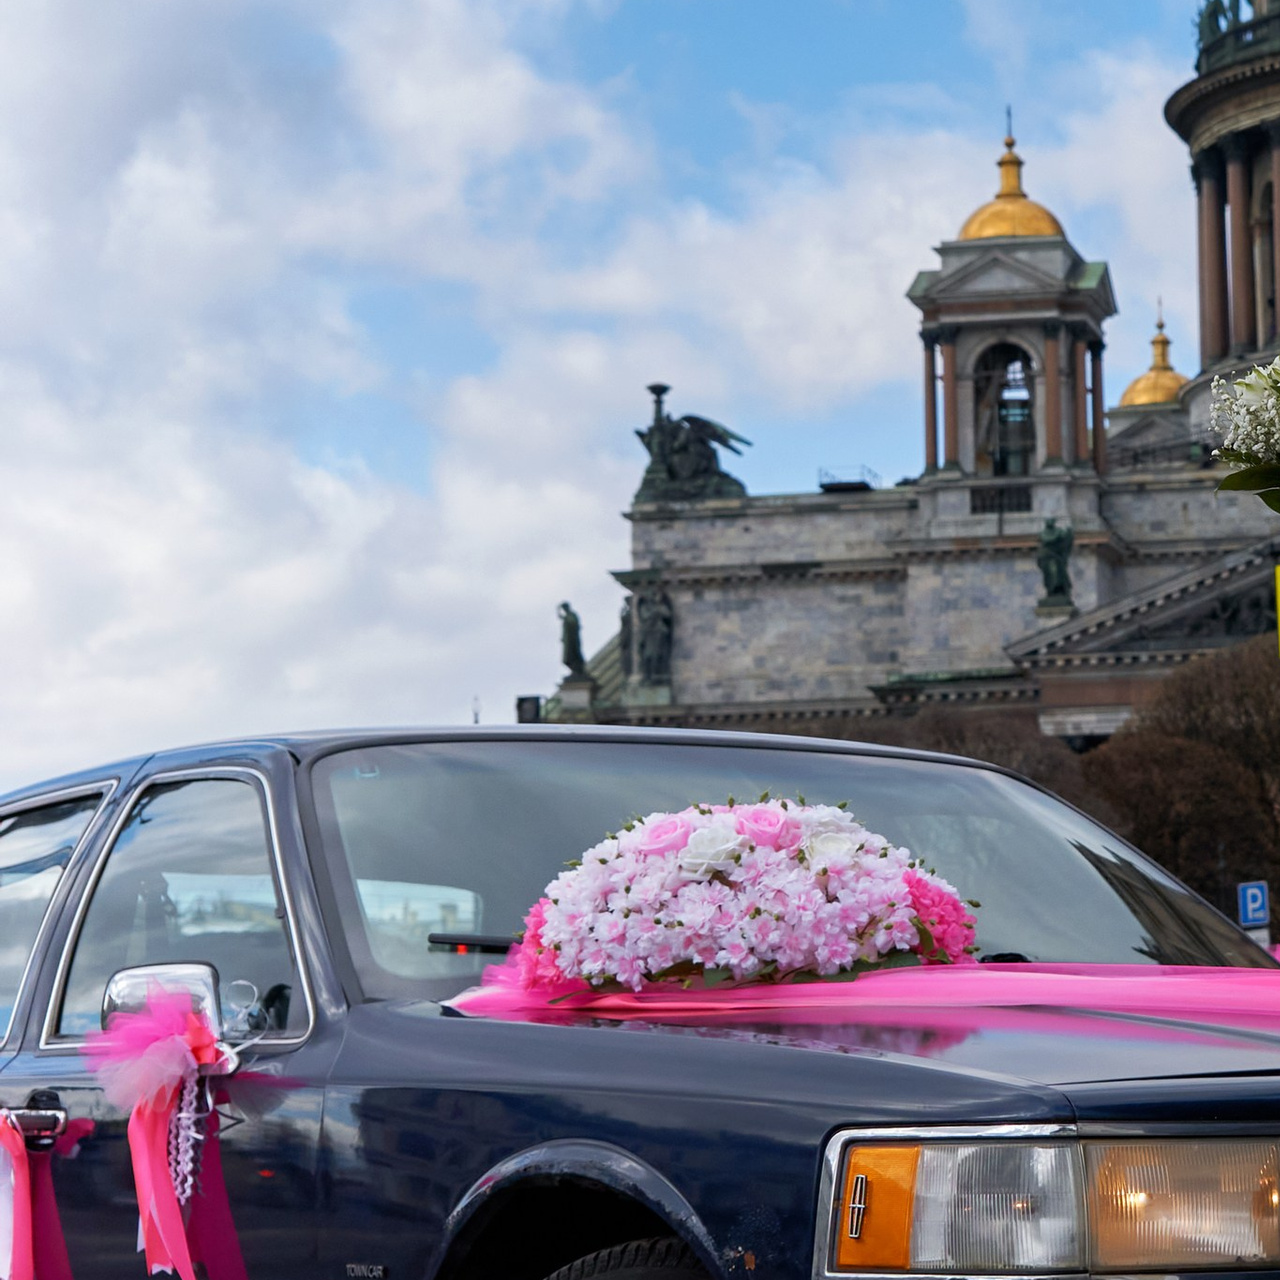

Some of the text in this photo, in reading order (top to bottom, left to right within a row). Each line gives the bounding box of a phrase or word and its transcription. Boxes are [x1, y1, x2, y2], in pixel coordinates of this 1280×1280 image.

[1246, 887, 1263, 919] P
[346, 1264, 383, 1278] TOWN CAR
